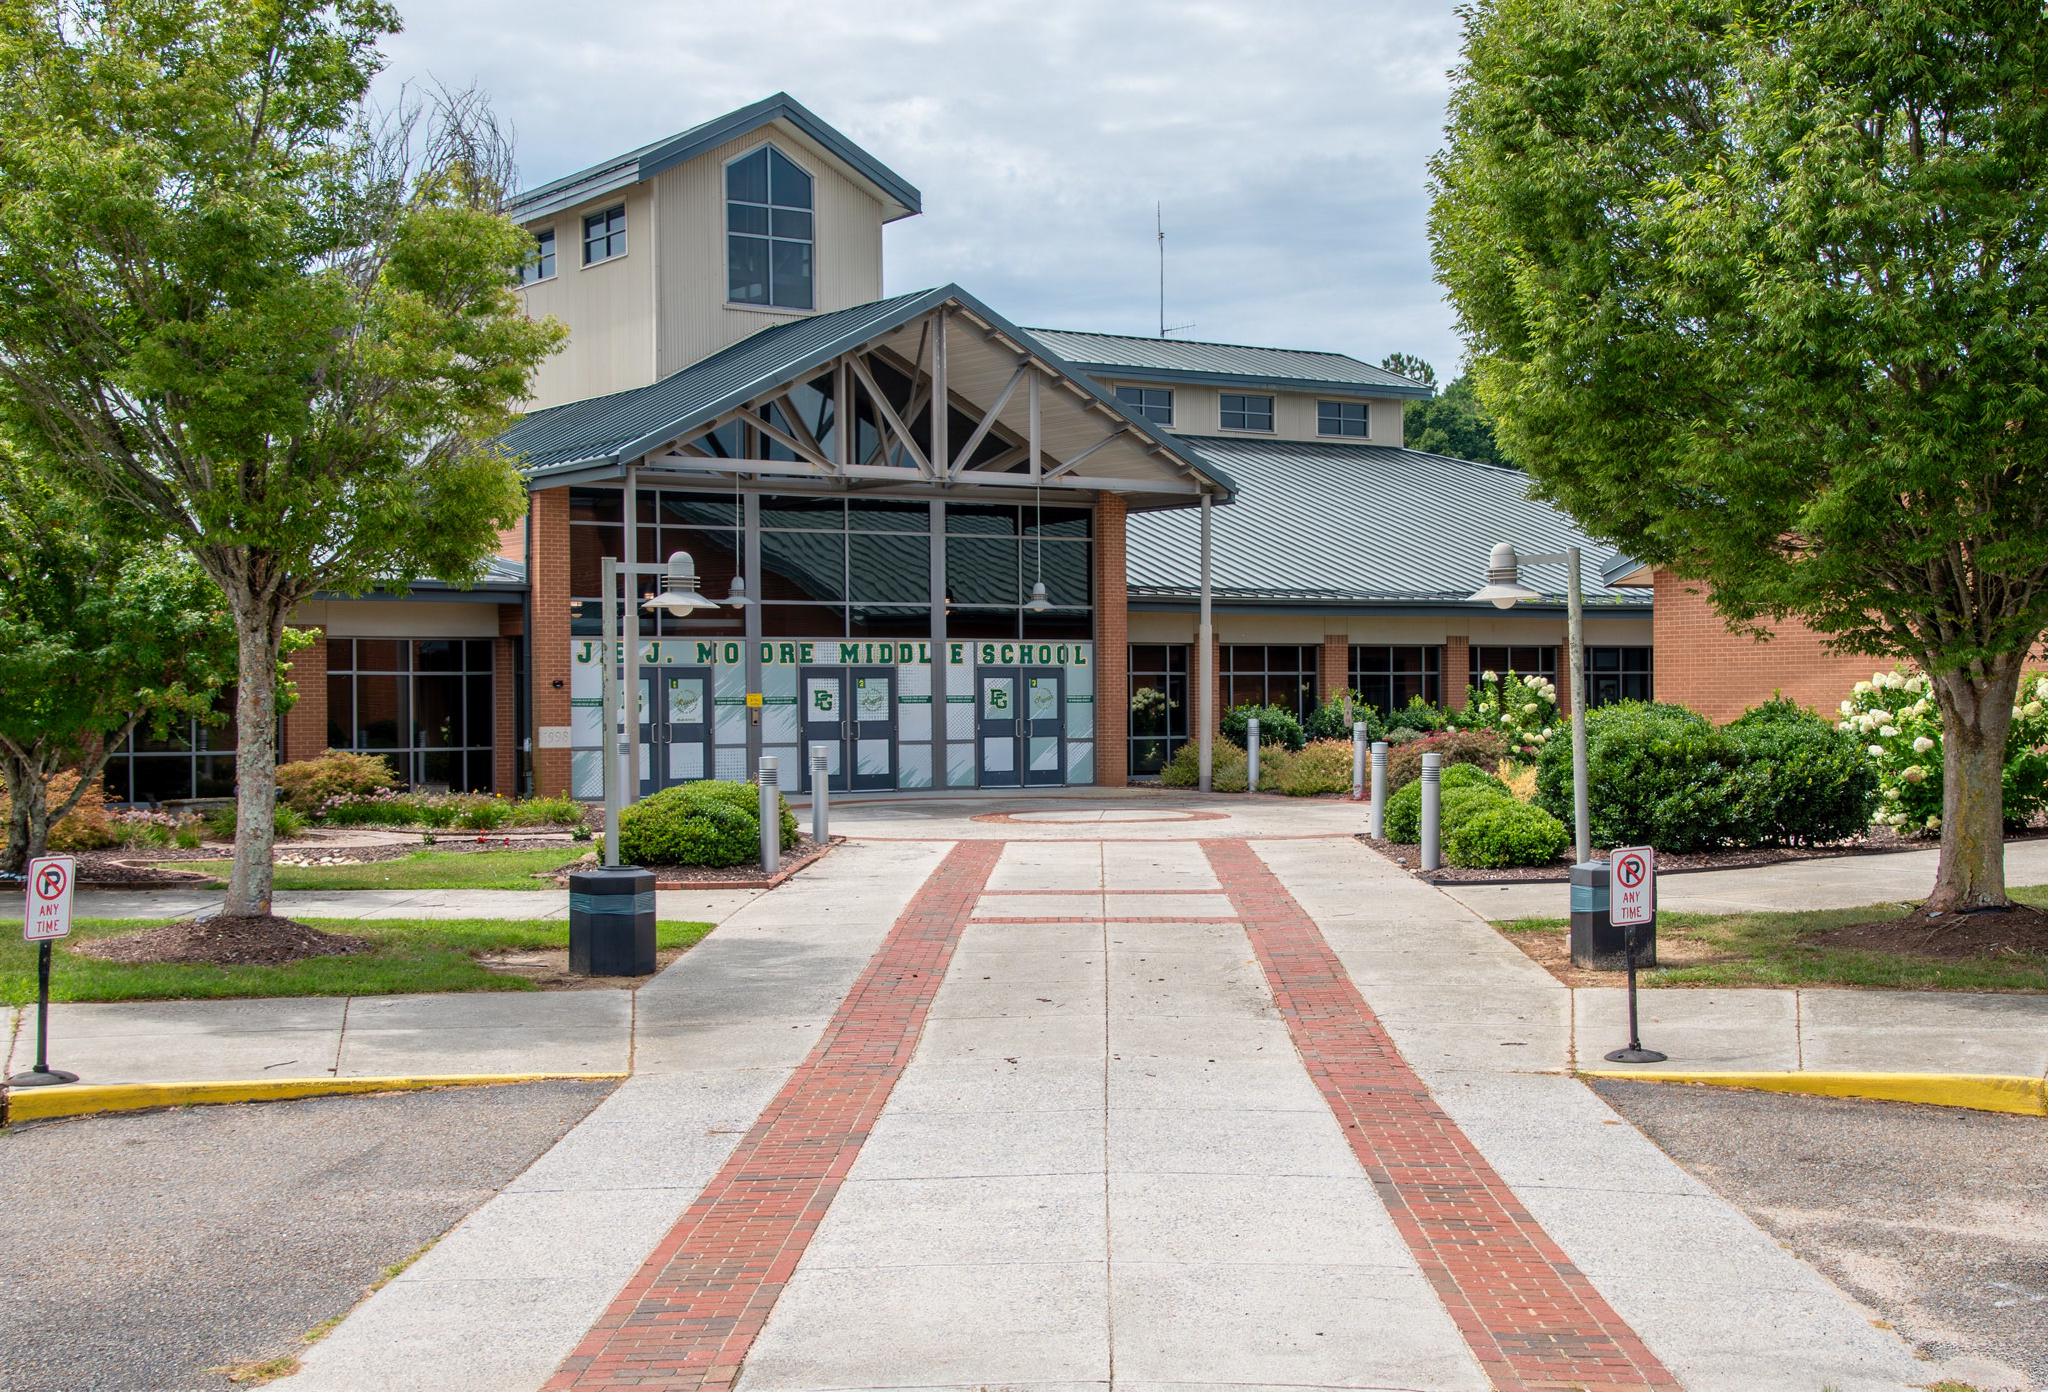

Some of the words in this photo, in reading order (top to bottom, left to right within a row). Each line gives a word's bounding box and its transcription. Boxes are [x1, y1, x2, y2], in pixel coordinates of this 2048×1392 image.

[695, 641, 815, 665] MOORE
[838, 642, 964, 665] MIDDLE
[981, 643, 1087, 665] SCHOOL
[1622, 891, 1641, 904] ANY
[38, 903, 60, 917] ANY
[1621, 906, 1642, 919] TIME
[36, 919, 60, 934] TIME
